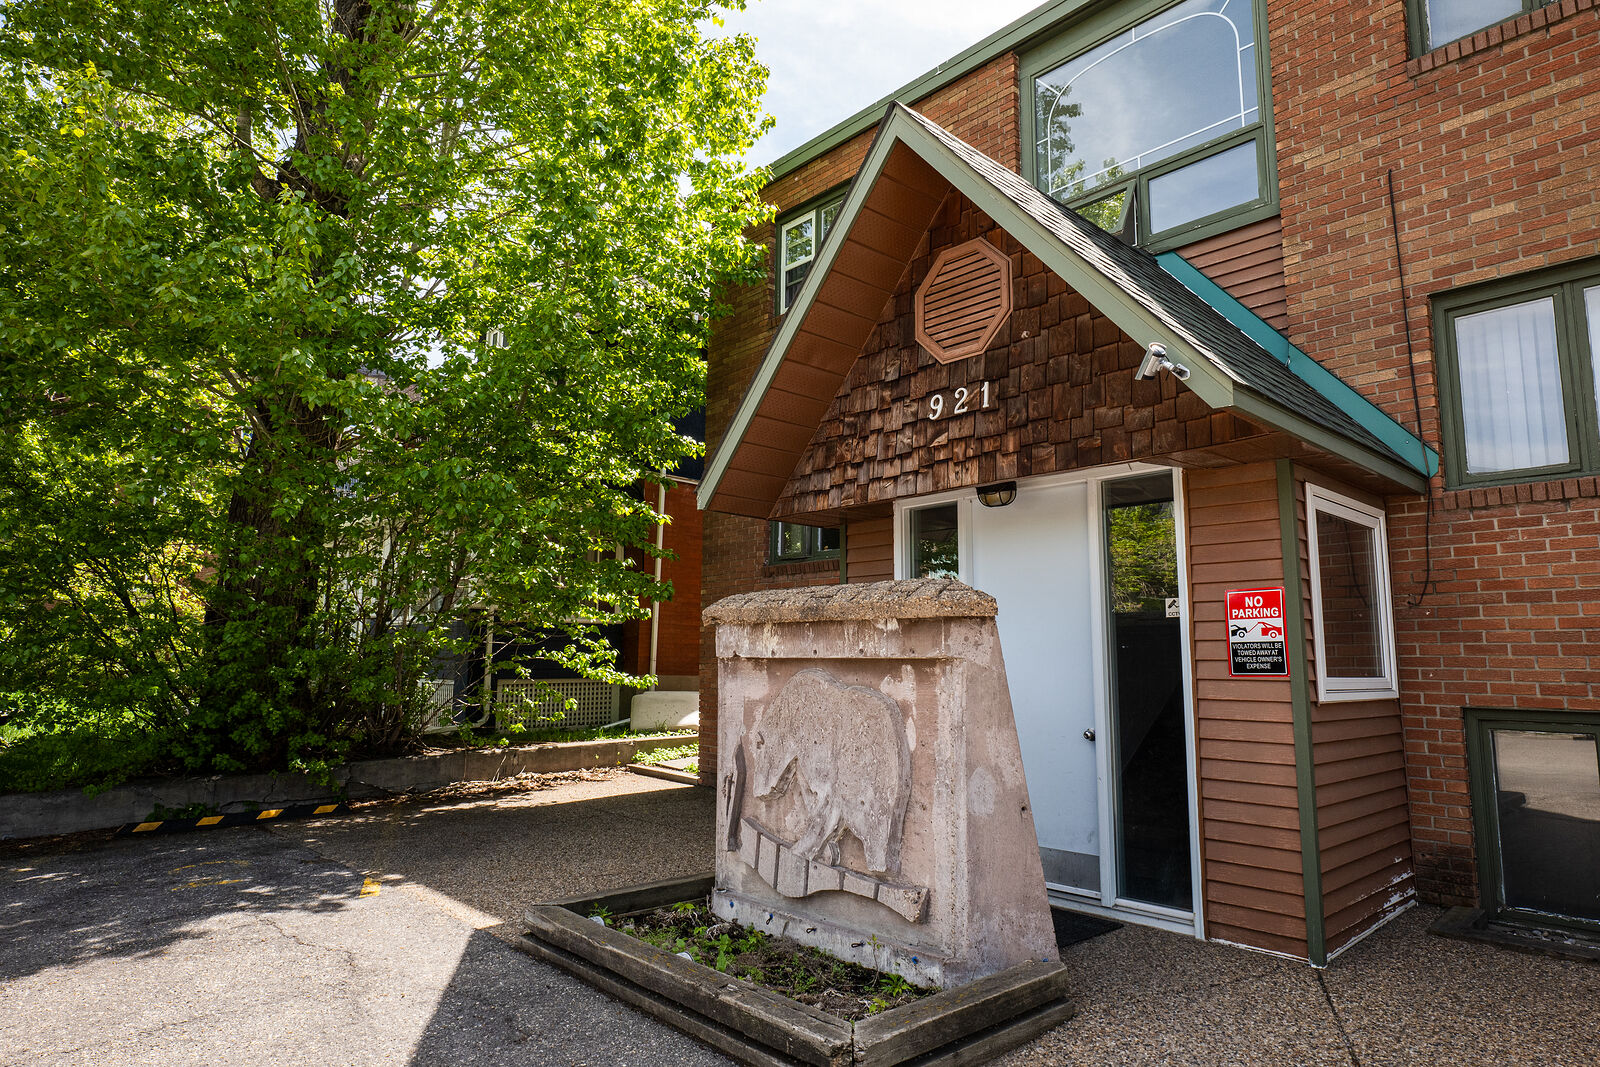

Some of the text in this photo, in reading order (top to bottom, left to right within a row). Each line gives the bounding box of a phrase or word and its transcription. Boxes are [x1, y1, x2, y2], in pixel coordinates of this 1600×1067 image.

[928, 381, 989, 420] 921
[1245, 596, 1263, 607] NO
[1232, 607, 1279, 618] PARKING
